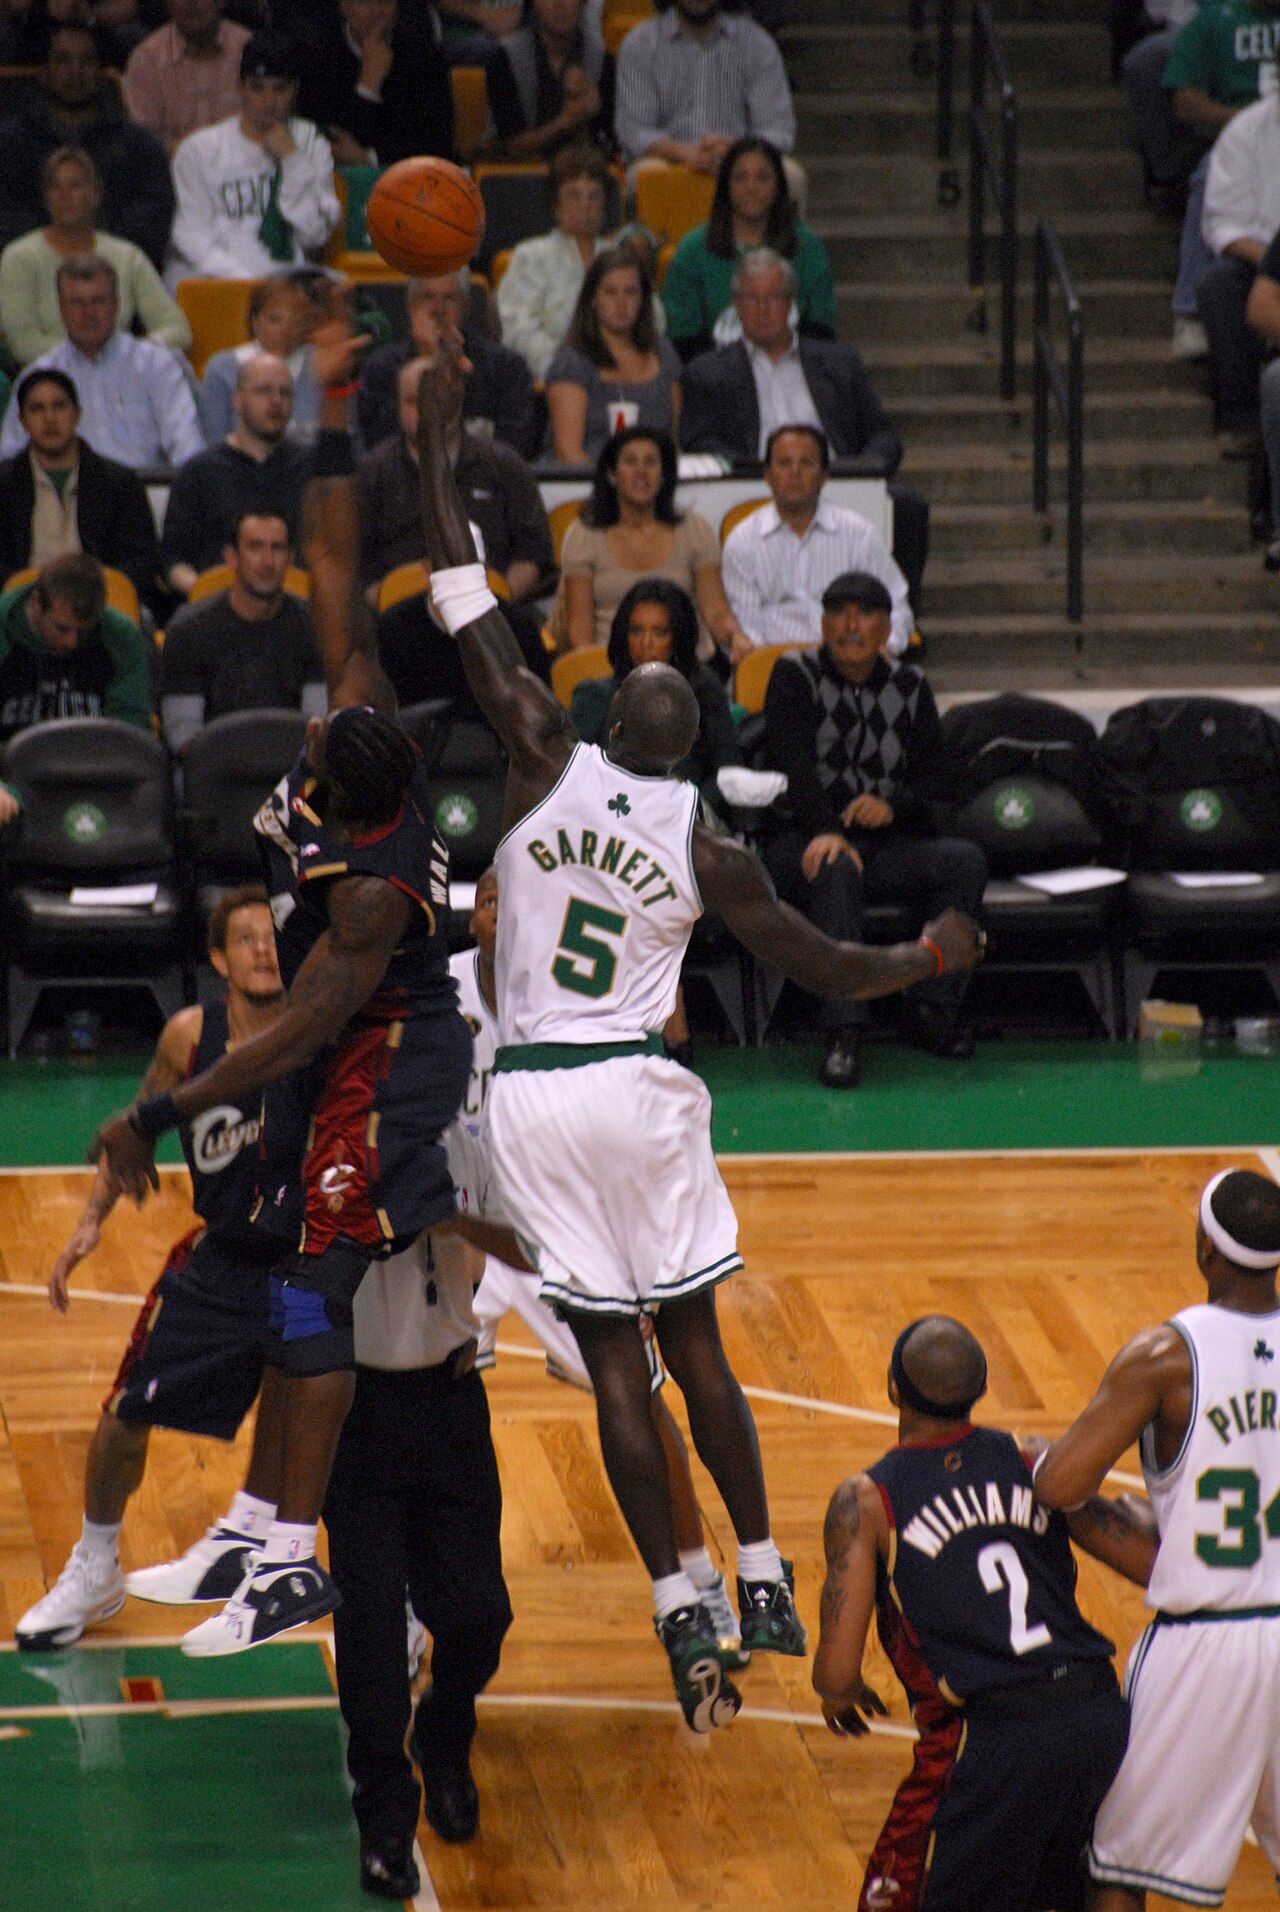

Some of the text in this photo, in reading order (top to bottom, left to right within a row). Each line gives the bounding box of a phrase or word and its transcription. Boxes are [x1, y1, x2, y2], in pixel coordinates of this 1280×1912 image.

[938, 169, 961, 207] 5
[527, 828, 677, 908] GARNETT
[550, 895, 630, 999] 5
[1205, 1388, 1280, 1445] PIER
[902, 1481, 1049, 1559] WILLIAMS
[1194, 1465, 1280, 1570] 3
[977, 1540, 1053, 1657] 2
